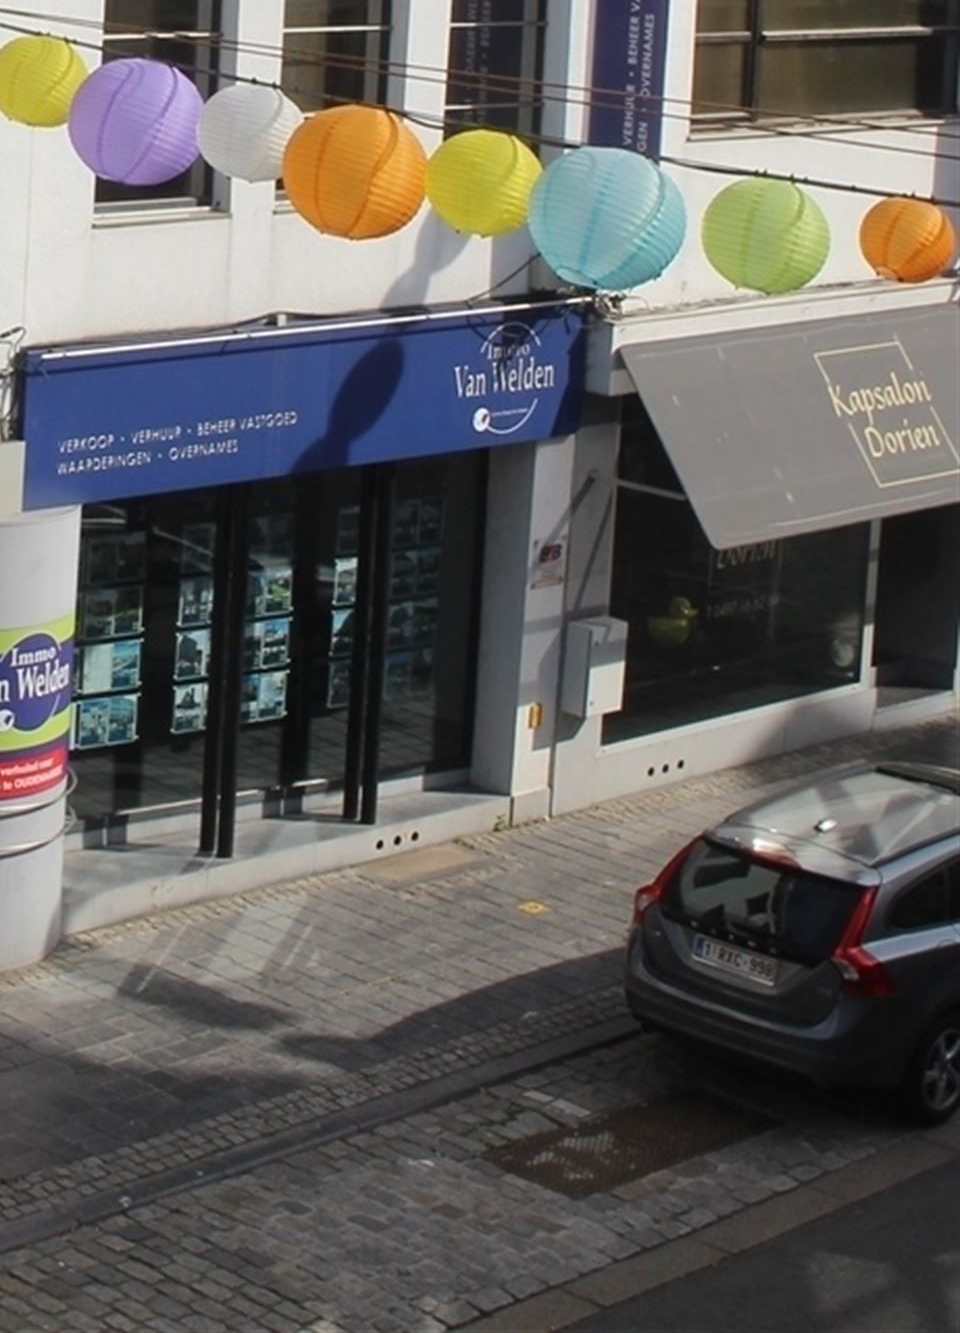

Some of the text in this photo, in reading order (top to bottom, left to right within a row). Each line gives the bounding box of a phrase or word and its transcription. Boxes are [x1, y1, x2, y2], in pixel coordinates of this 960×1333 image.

[627, 17, 641, 65] BEHEER
[639, 13, 655, 99] OVERNAMES
[454, 365, 486, 398] Van
[828, 372, 932, 426] Kapsalon
[57, 410, 298, 454] VERKOOP VERHUUR BEHEER VASTGOED
[864, 419, 940, 458] Dorien
[56, 439, 239, 476] WAARDERINGEN OVERNAMES
[10, 647, 57, 667] Immo
[16, 660, 70, 700] Welden
